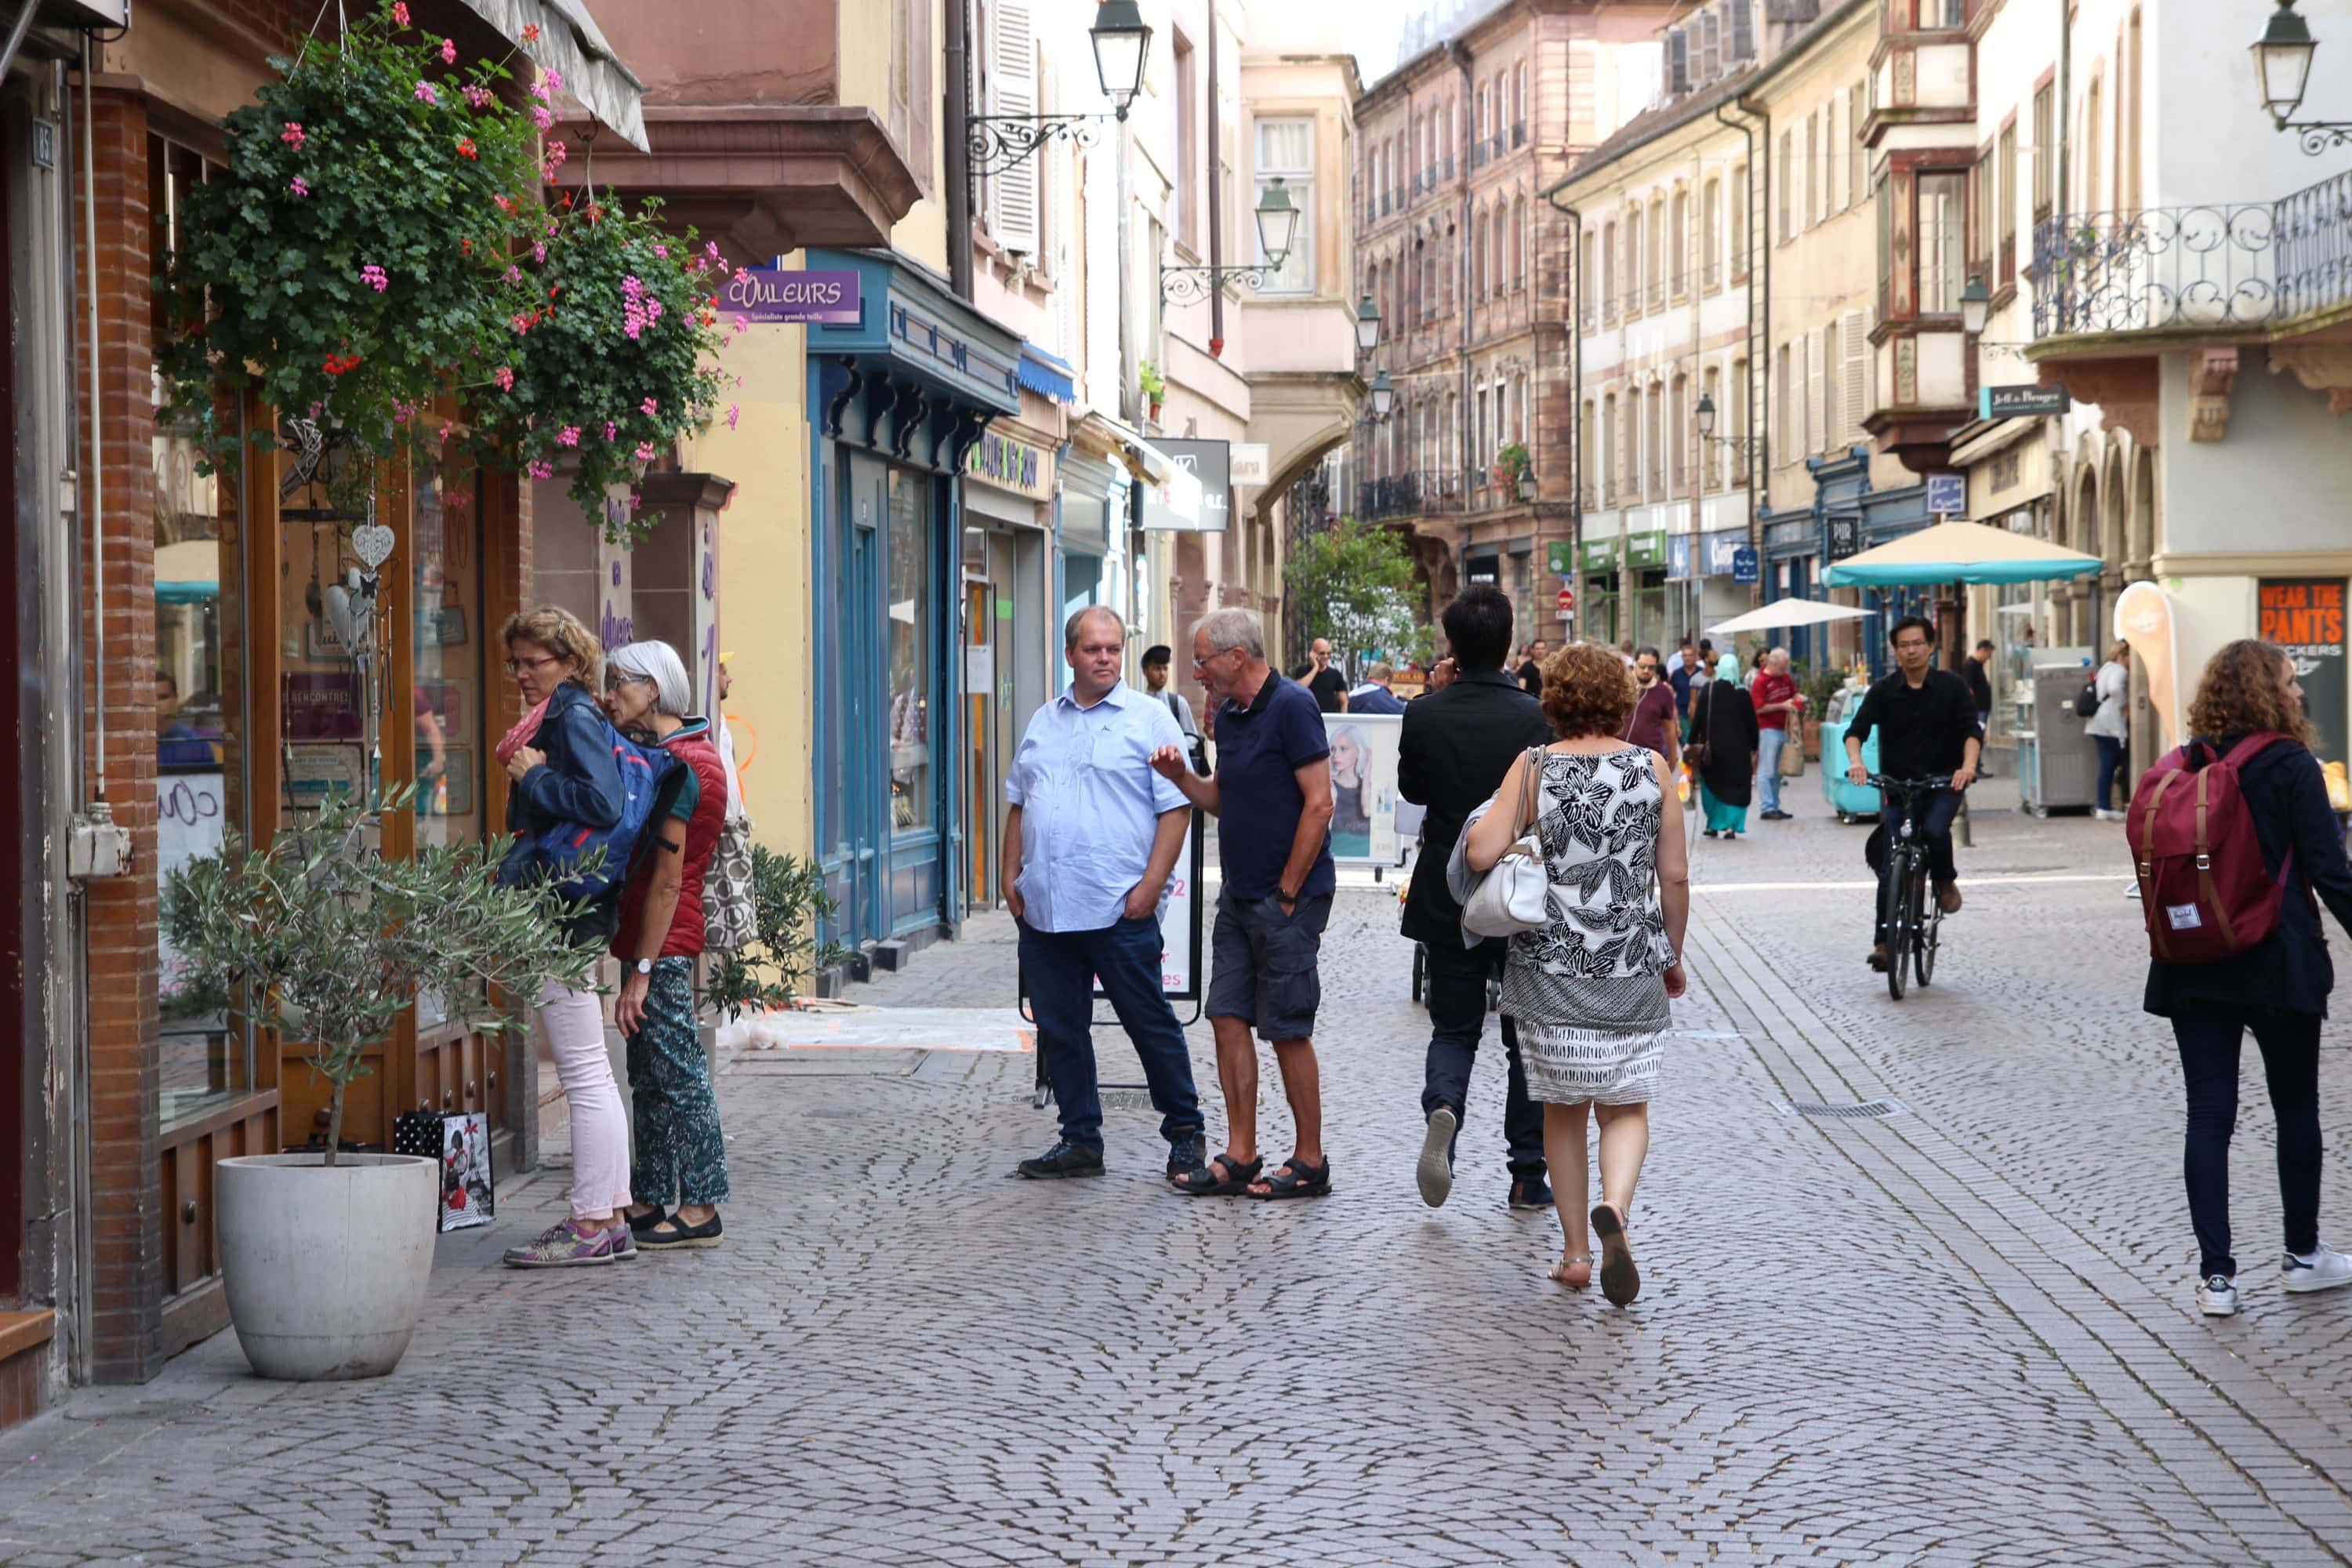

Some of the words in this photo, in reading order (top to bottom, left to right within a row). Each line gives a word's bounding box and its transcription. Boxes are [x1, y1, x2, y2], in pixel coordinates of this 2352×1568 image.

[39, 127, 49, 161] 85
[751, 313, 783, 321] Spécialiste
[784, 314, 805, 322] grande
[806, 313, 822, 321] taille
[2261, 586, 2307, 608] WEAR
[2311, 585, 2342, 608] THE
[2260, 608, 2343, 644] PANTS
[2285, 644, 2342, 656] CKERS
